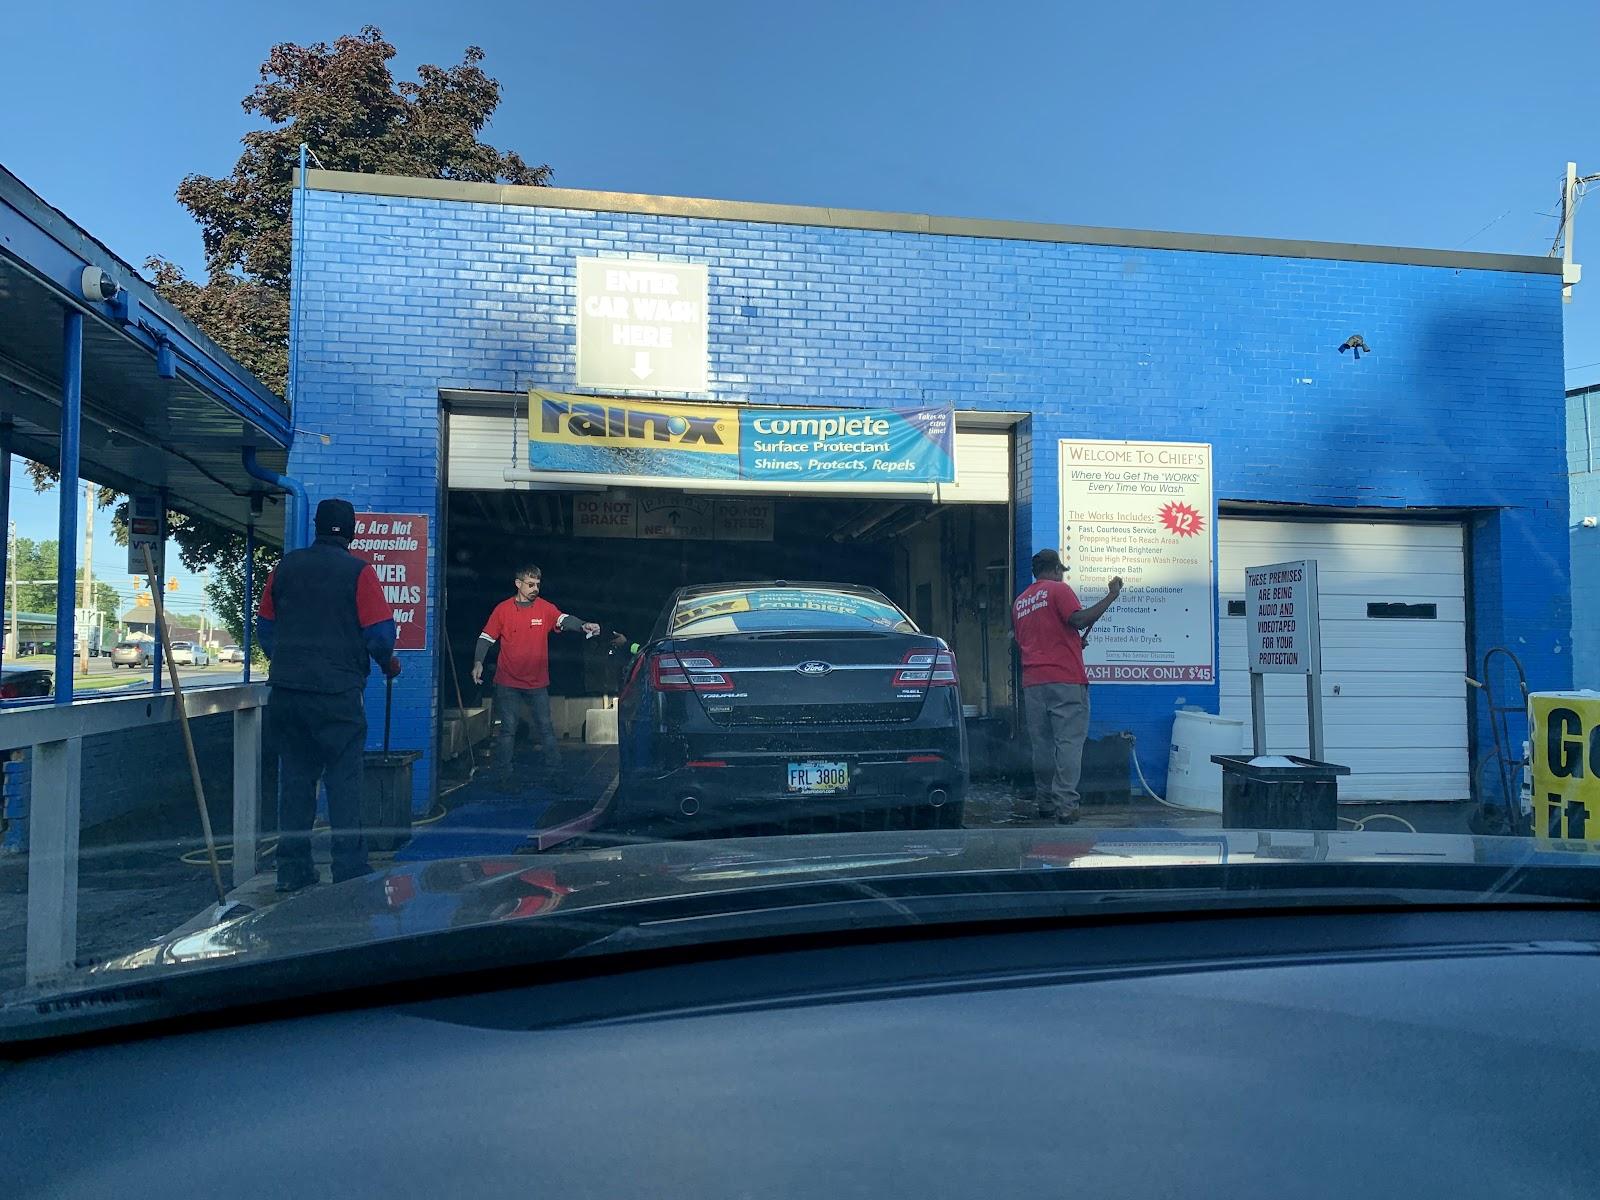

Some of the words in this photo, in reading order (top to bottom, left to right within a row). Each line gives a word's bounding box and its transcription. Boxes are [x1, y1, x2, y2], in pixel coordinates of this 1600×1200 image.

[606, 270, 679, 295] ENTER
[585, 296, 630, 319] CAR
[632, 298, 698, 323] WASH
[612, 324, 673, 348] HERE
[753, 416, 890, 441] Complete
[753, 440, 809, 453] Surface
[813, 442, 890, 453] Protectant
[754, 458, 802, 471] Shines,
[808, 459, 868, 472] Protects,
[872, 459, 916, 472] Repels
[1072, 470, 1102, 480] Where
[1104, 471, 1121, 480] You
[1123, 472, 1140, 480] Get
[1143, 472, 1159, 481] The
[1088, 482, 1114, 493] Every
[1116, 483, 1138, 492] Time
[1140, 484, 1157, 492] You
[1159, 484, 1184, 493] Wash
[578, 502, 598, 513] DO
[604, 502, 632, 514] NOT
[581, 514, 629, 526] BRAKE
[1069, 510, 1084, 520] The
[1088, 511, 1114, 520] Works
[1117, 512, 1154, 522] Includes:
[1171, 508, 1193, 531] $12
[368, 521, 389, 535] Are
[392, 521, 412, 535] Not
[1096, 526, 1130, 534] Courteous
[348, 538, 418, 552] esponsible
[1080, 534, 1110, 544] Prepping
[1139, 536, 1159, 544] Reach
[1128, 546, 1162, 555] Brightener
[374, 553, 386, 561] For
[1080, 555, 1104, 563] Unique
[1105, 556, 1120, 564] High
[1122, 556, 1151, 564] Pressure
[1152, 556, 1171, 564] Wash
[1172, 557, 1198, 565] Process
[1079, 566, 1126, 575] Undercarriage
[1248, 574, 1267, 586] THESE
[1268, 568, 1302, 584] PREMISES
[1079, 586, 1110, 594] Foaming
[1128, 586, 1144, 594] Coat
[1146, 586, 1184, 594] Conditioner
[1258, 588, 1271, 601] ARE
[1272, 586, 1292, 600] BEING
[1016, 589, 1048, 610] Chief's
[1116, 606, 1150, 614] Protectant
[1258, 604, 1278, 616] AUDIO
[1280, 602, 1294, 616] AND
[392, 609, 414, 623] Not
[1126, 626, 1146, 634] Shine
[1258, 620, 1296, 633] VIDEOTAPED
[1096, 636, 1104, 644] Hp
[1140, 636, 1162, 644] Dryers
[1262, 637, 1274, 648] FOR
[1276, 636, 1294, 648] YOUR
[1259, 652, 1298, 664] PROTECTION
[804, 662, 825, 673] Ford
[1114, 667, 1150, 679] BOOK
[1154, 667, 1186, 679] ONLY
[790, 769, 812, 786] FRL
[816, 768, 844, 785] 3808
[1548, 792, 1590, 840] it
